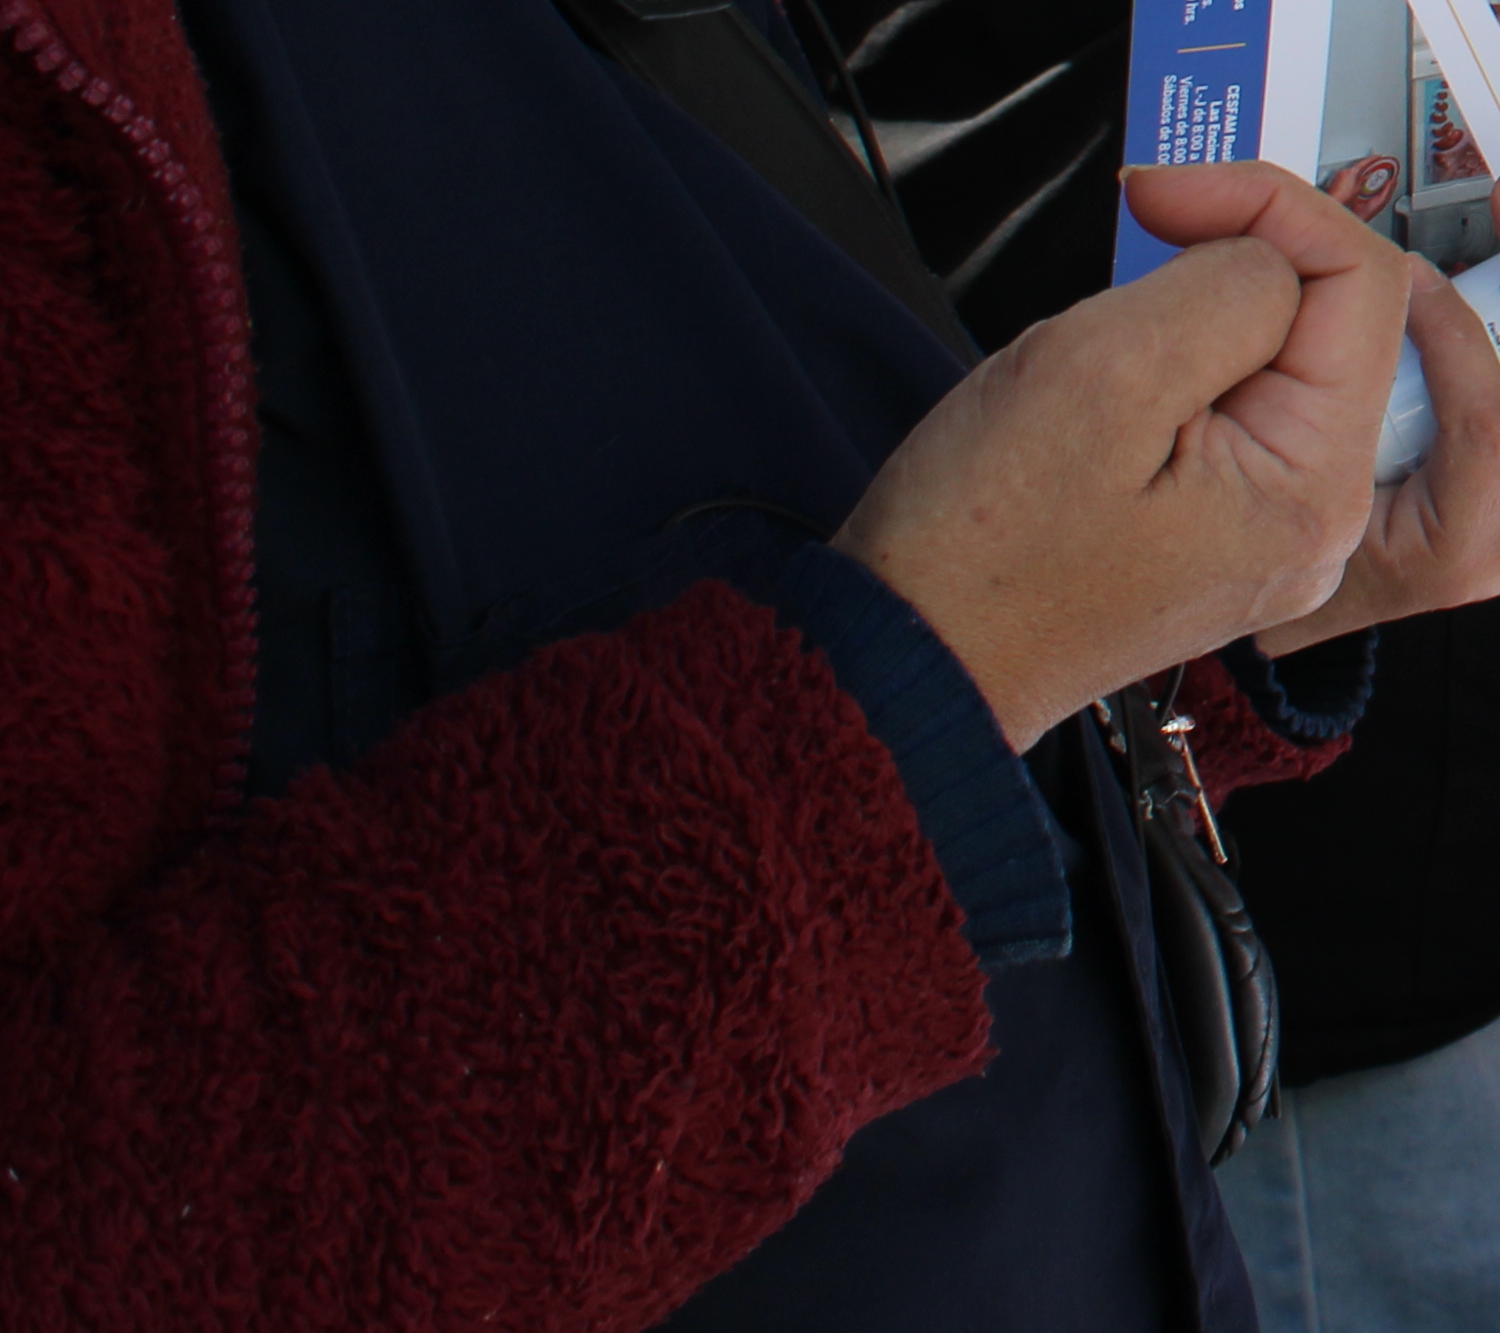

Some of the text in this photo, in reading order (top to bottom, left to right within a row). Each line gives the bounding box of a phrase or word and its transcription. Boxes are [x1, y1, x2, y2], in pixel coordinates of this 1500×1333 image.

[1184, 3, 1198, 25] hrs.
[1161, 75, 1177, 124] Sábados
[1174, 75, 1193, 163] Viernes de 8:00
[1190, 85, 1208, 161] L-J de 8:00 a
[1209, 101, 1223, 122] Las
[1224, 85, 1240, 133] CESFAM
[1159, 126, 1173, 141] de
